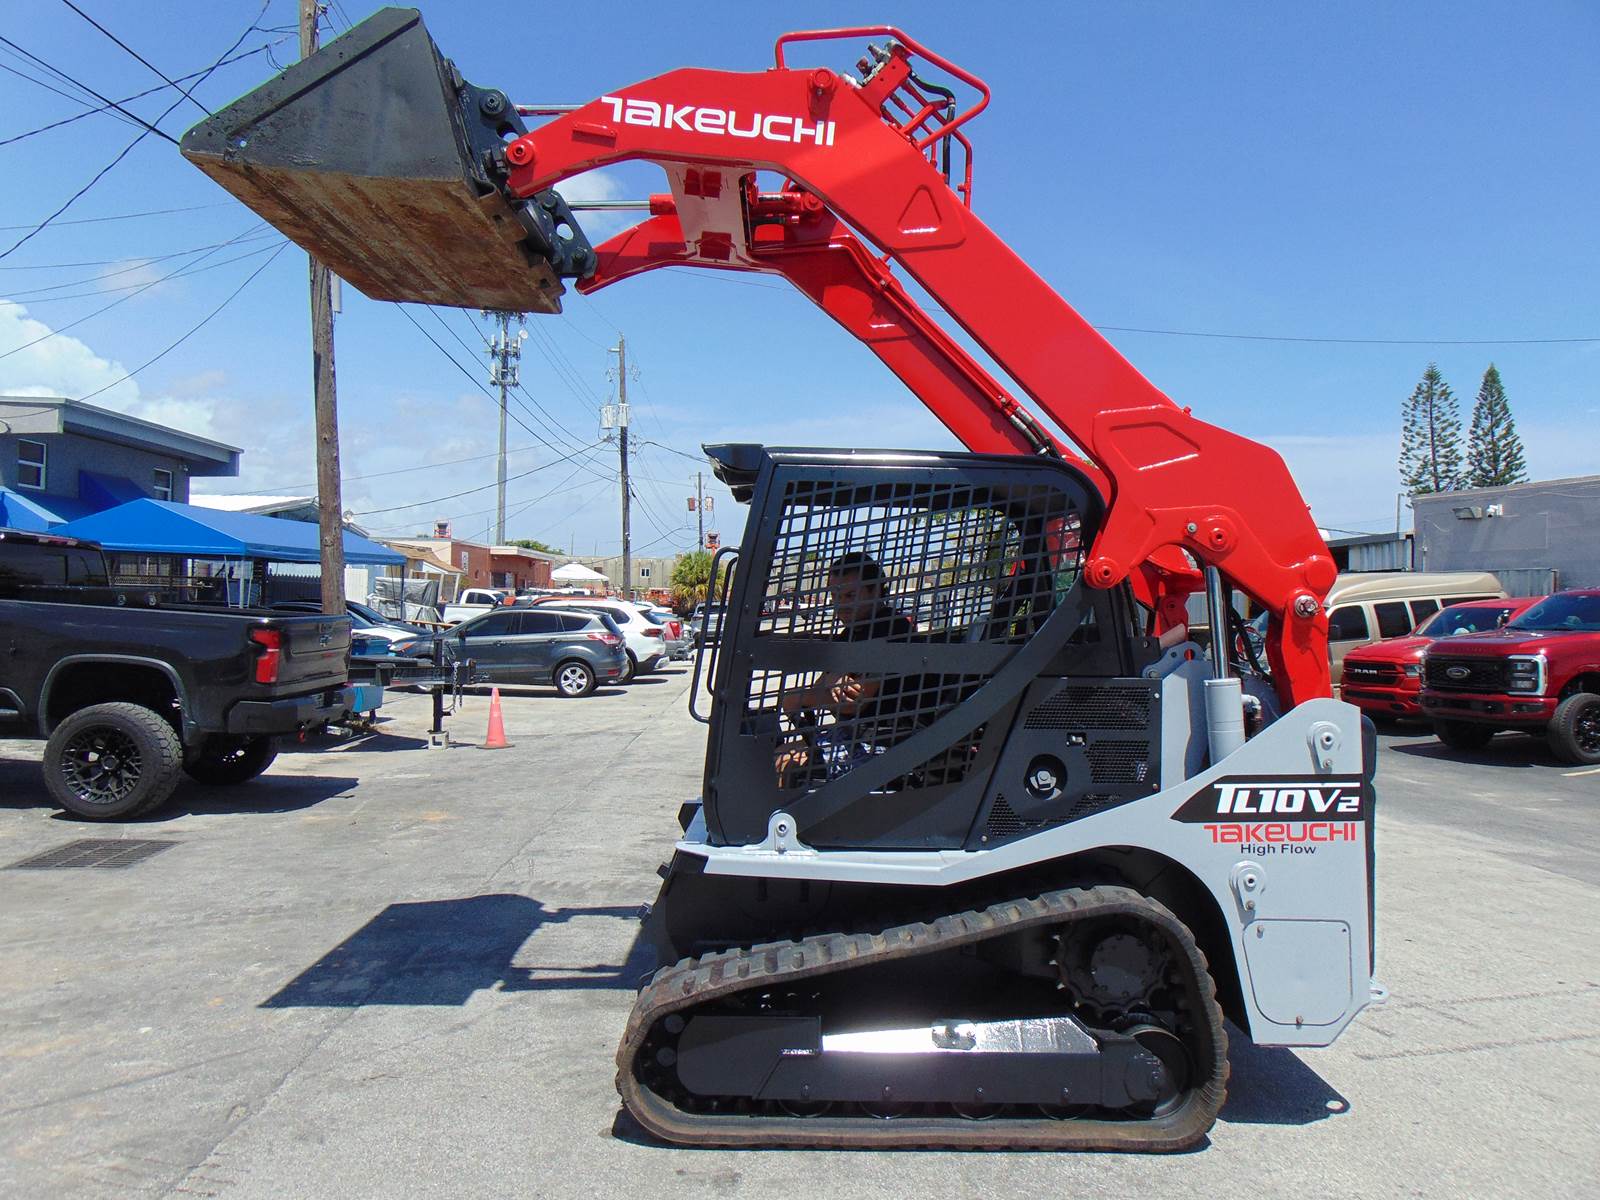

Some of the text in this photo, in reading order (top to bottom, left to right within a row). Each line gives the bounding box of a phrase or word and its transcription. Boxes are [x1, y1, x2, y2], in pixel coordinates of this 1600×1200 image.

[1214, 782, 1361, 814] TL10V2
[1240, 843, 1317, 857] High Flow
